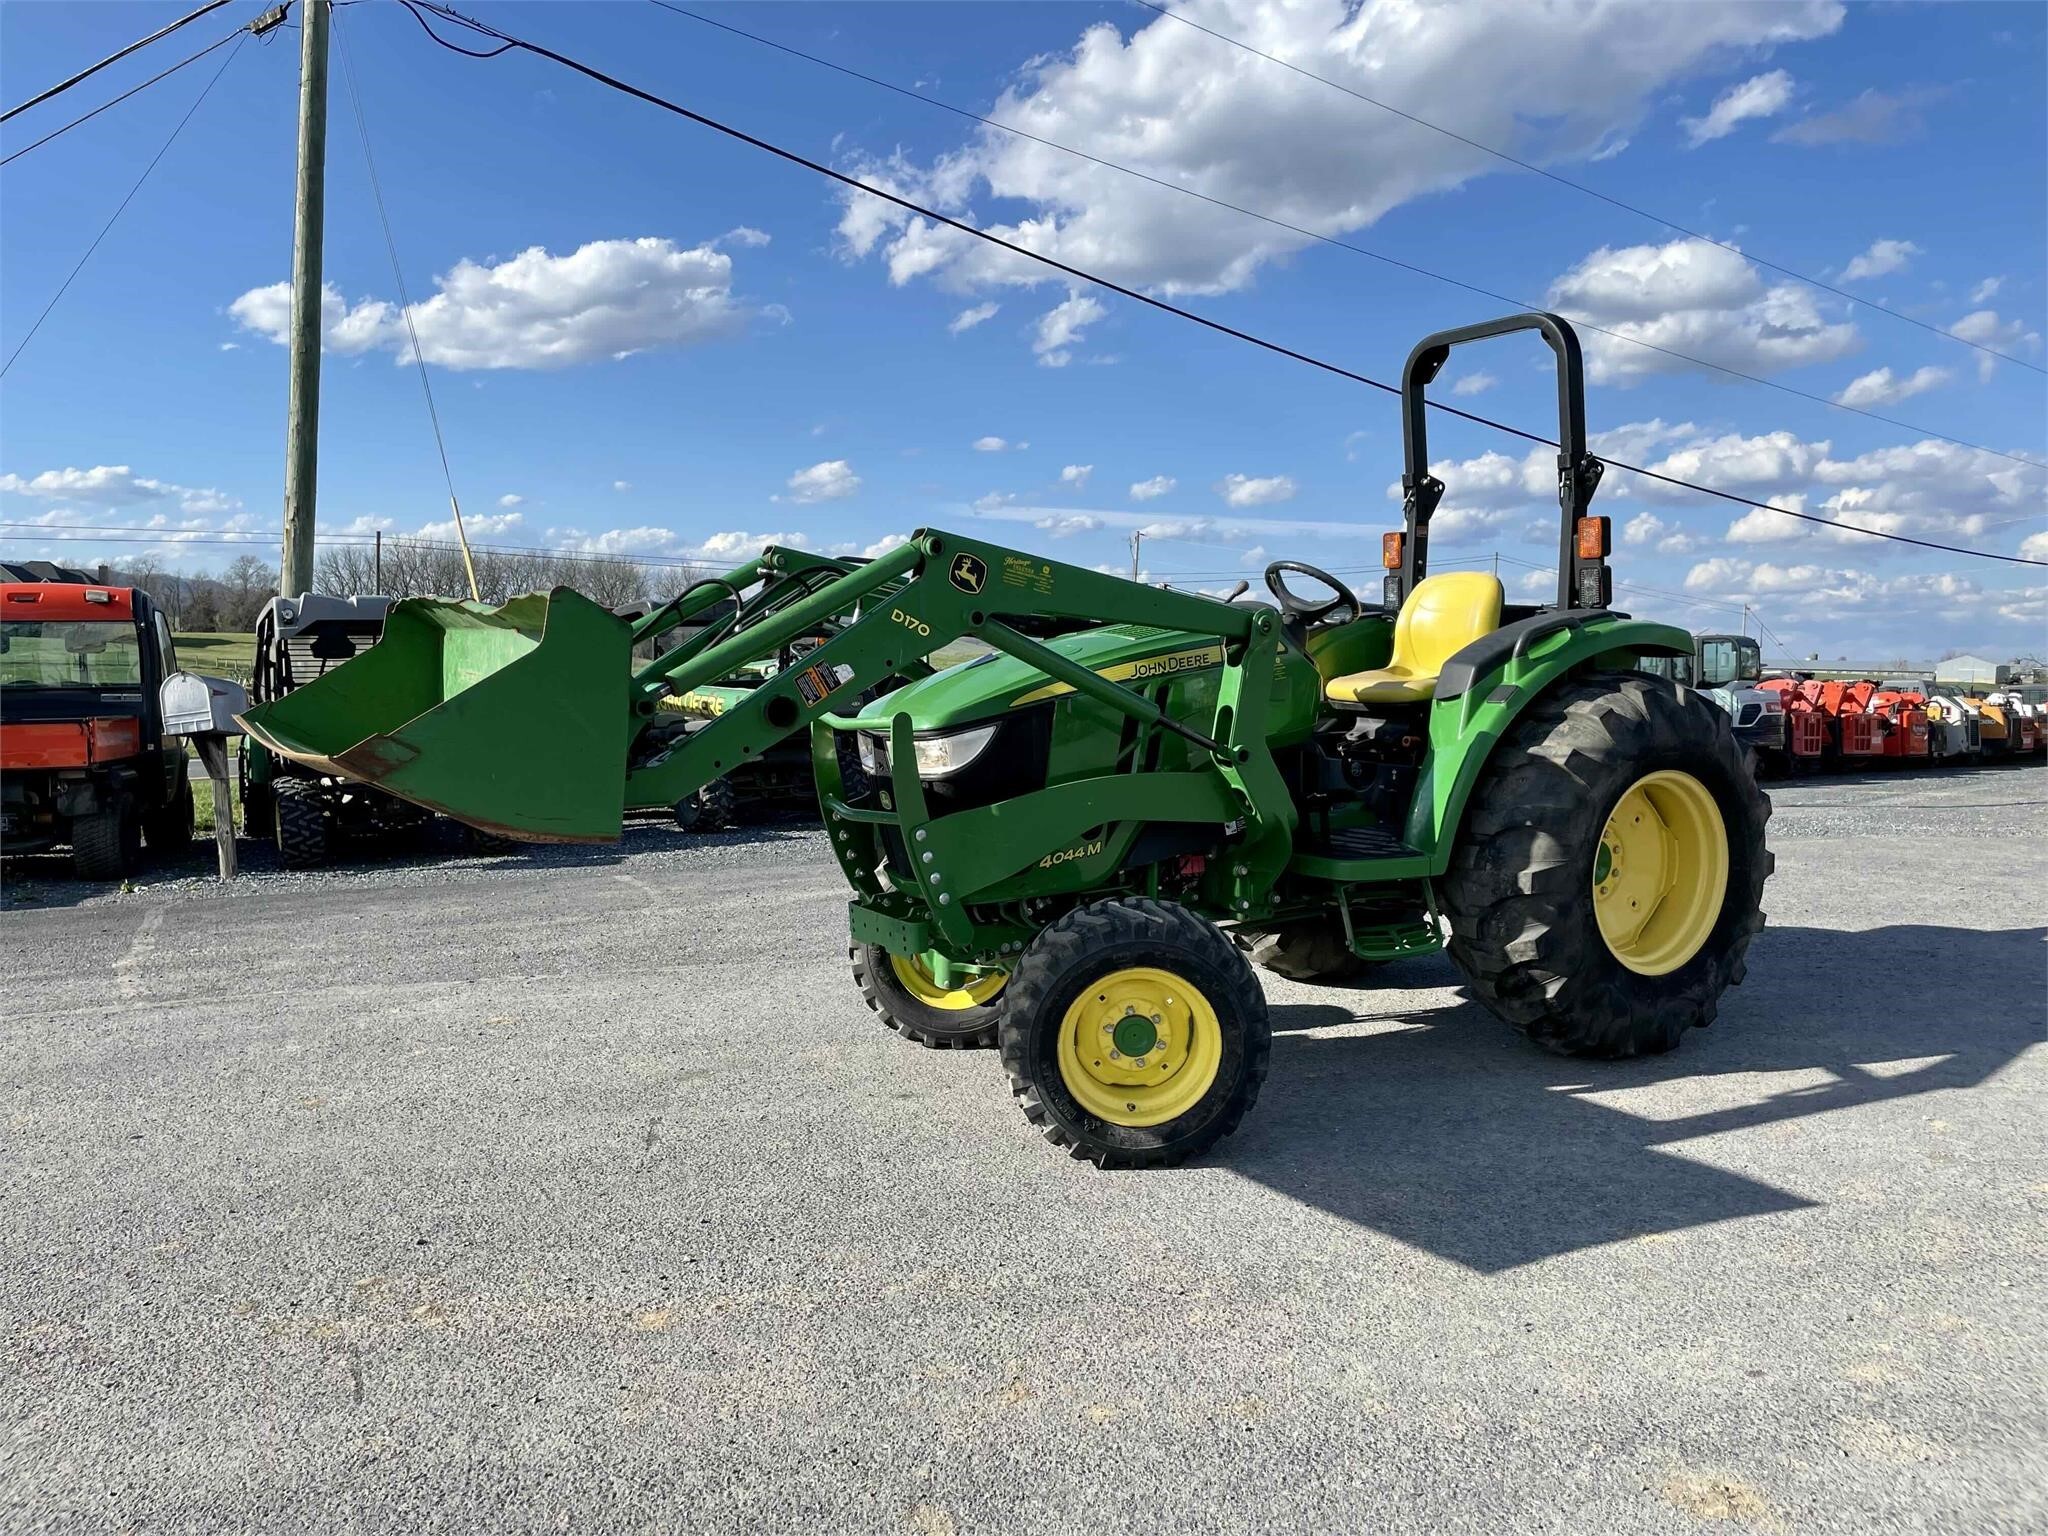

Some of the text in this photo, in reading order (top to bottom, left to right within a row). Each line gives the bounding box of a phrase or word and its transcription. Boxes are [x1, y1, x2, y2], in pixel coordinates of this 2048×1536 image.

[891, 608, 931, 637] D170
[1130, 653, 1210, 678] JOHN DEERE
[1039, 841, 1102, 868] 4044M
